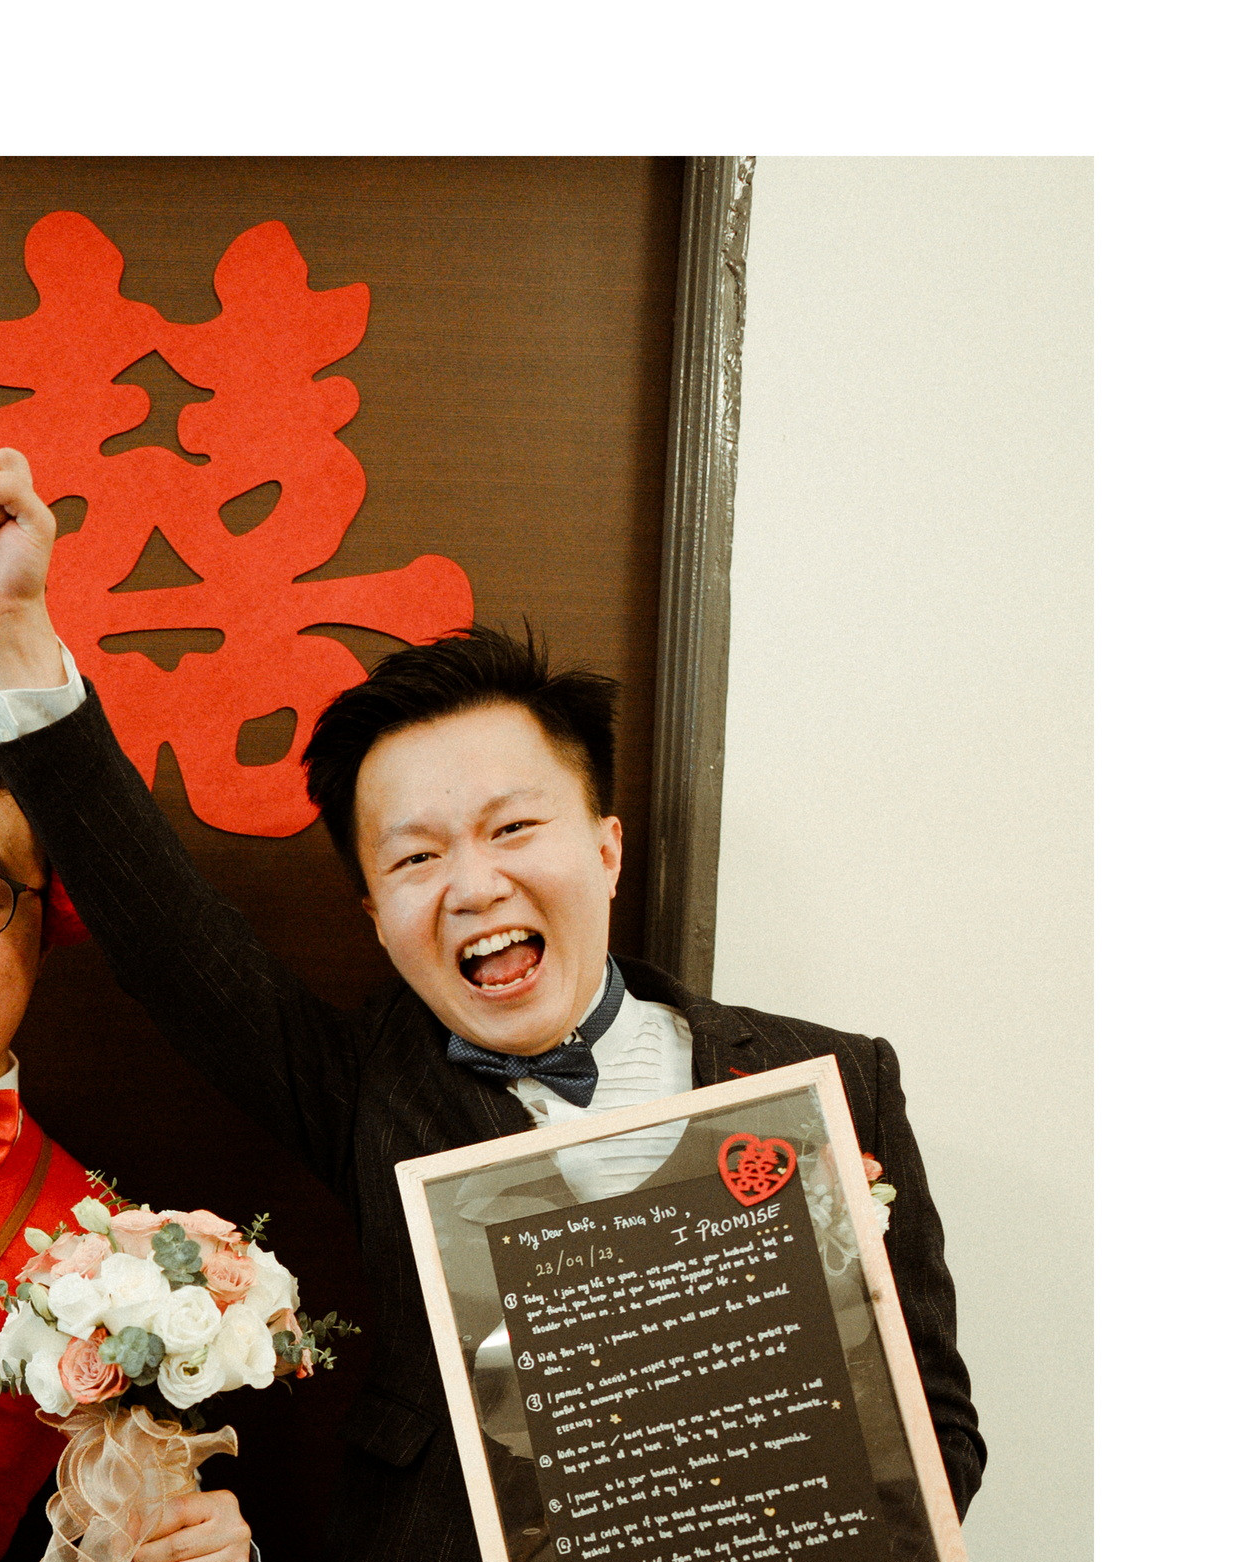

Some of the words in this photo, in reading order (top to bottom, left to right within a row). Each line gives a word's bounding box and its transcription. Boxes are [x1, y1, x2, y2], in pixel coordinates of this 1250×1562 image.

[518, 1231, 540, 1251] My
[540, 1228, 564, 1241] Dear
[613, 1215, 647, 1230] FANG
[670, 1225, 688, 1245] I
[694, 1202, 780, 1242] PROMISE
